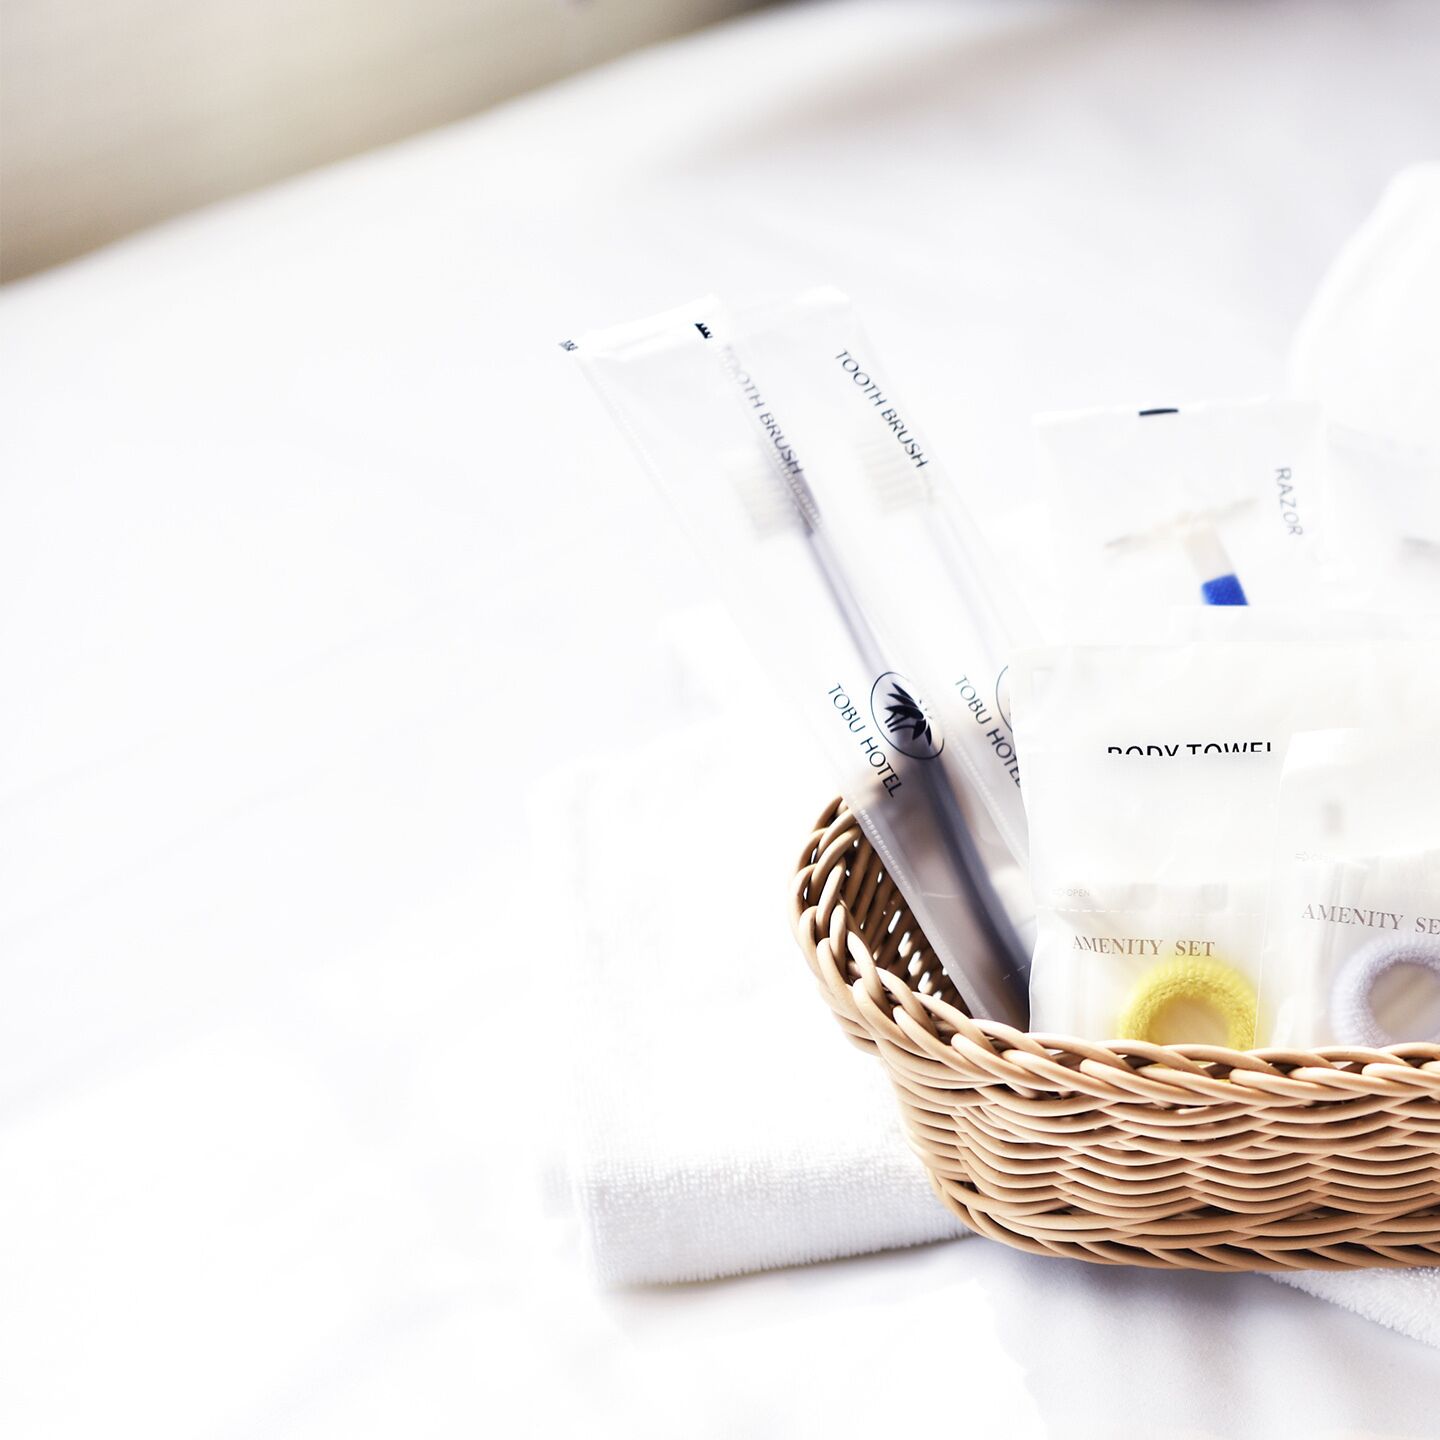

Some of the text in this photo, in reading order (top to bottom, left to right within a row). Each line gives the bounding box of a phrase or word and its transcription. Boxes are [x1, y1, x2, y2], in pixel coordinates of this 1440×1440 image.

[835, 349, 928, 468] TOOTH BRUSH
[759, 412, 804, 475] BRUSH
[1275, 467, 1303, 536] RAZOR
[955, 674, 992, 725] TOBU
[828, 682, 902, 798] TOBU HOTEL
[1073, 935, 1216, 958] AMENITY SET
[1301, 903, 1403, 931] AMENITY
